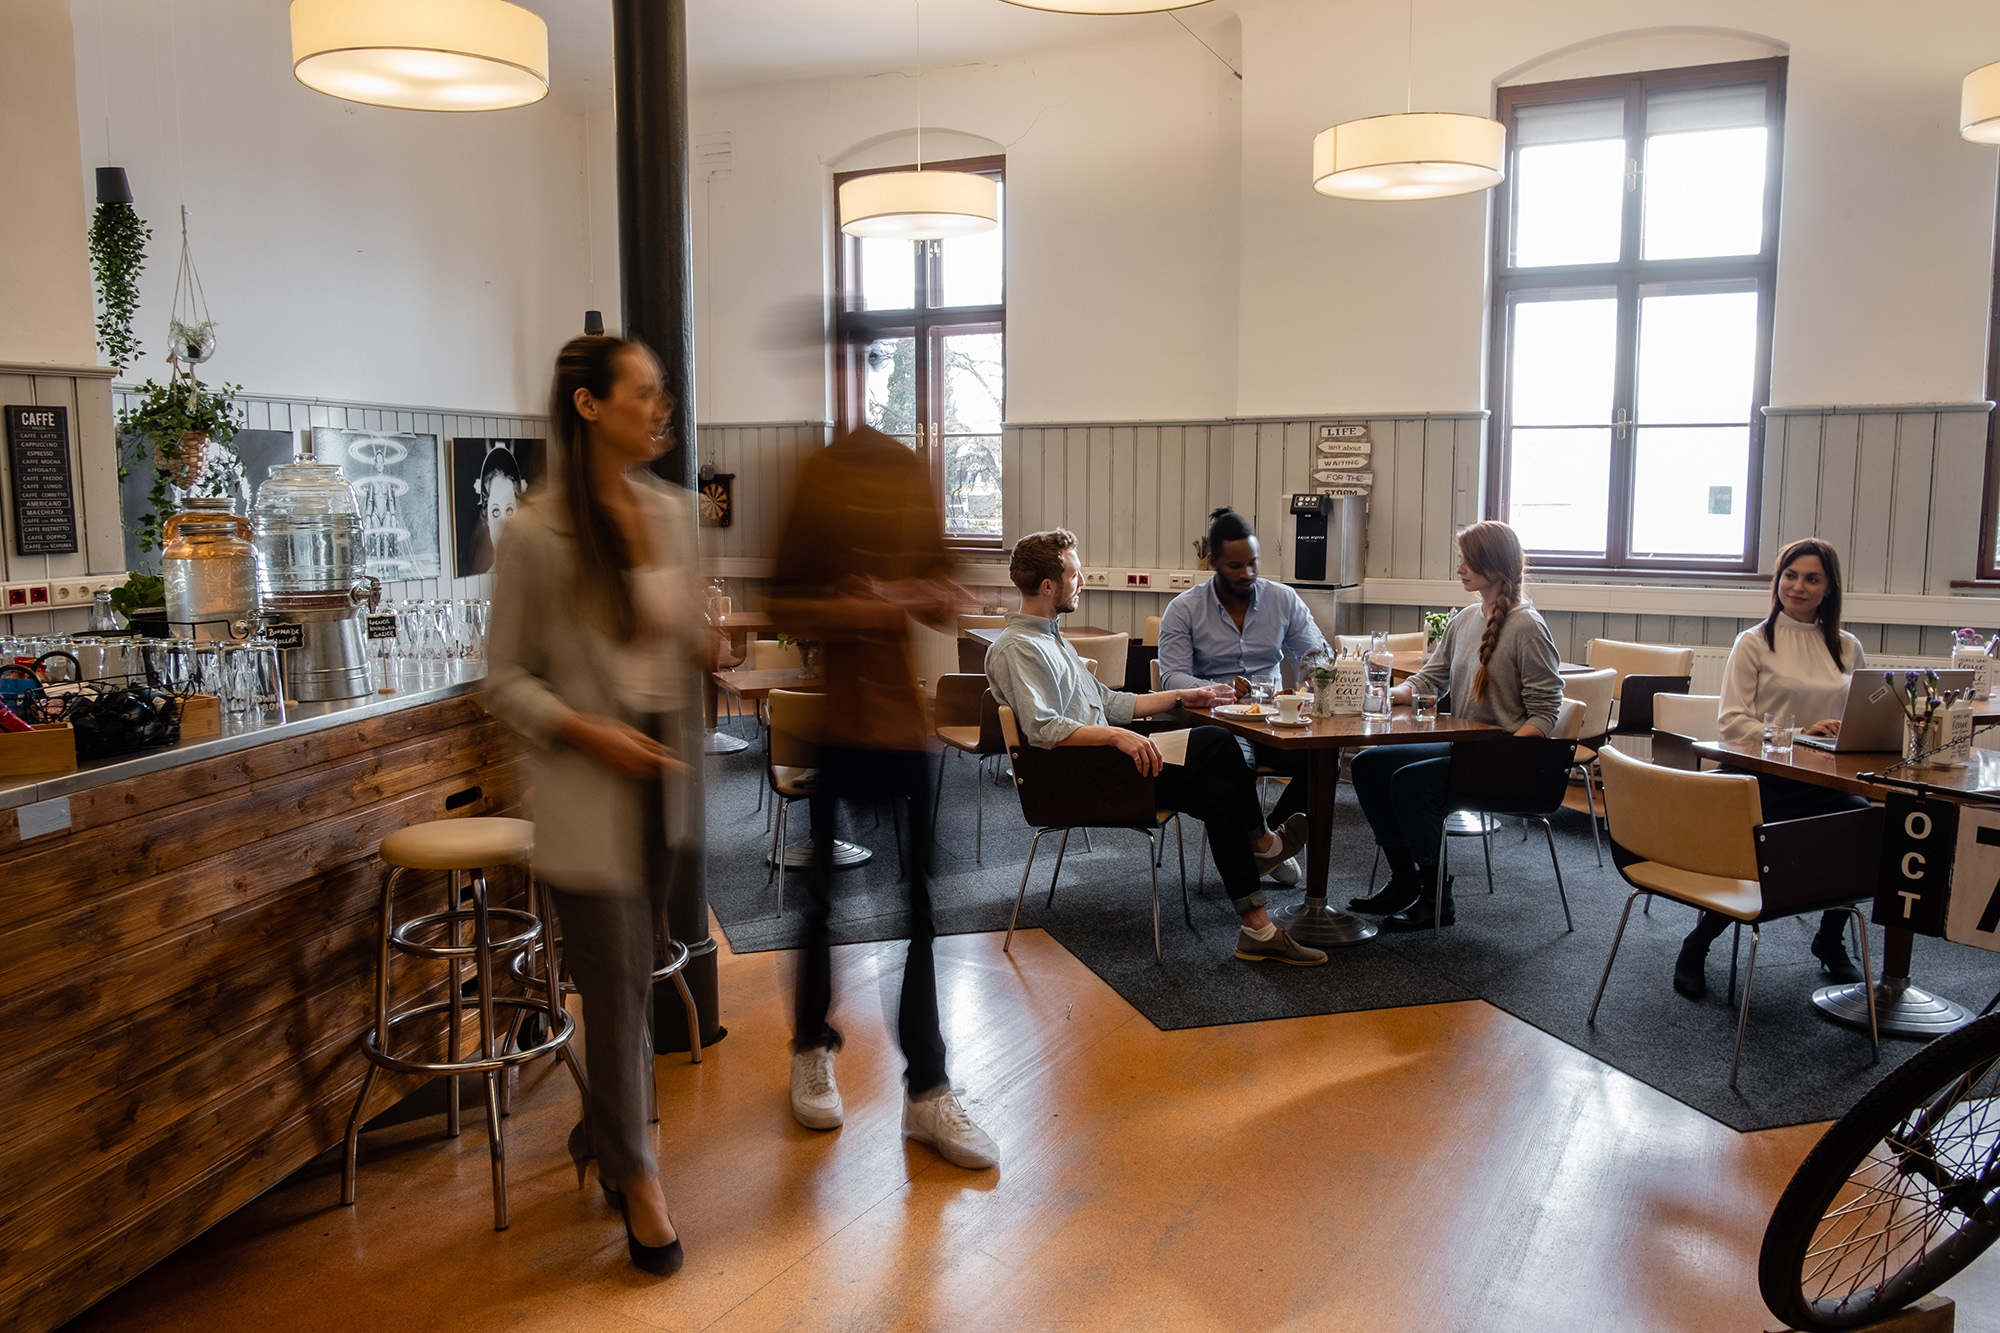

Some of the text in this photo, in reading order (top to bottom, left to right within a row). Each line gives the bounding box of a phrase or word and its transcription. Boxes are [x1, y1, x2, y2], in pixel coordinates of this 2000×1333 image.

[21, 412, 55, 426] CAFFÈ
[1327, 427, 1357, 436] LIFE
[1346, 474, 1363, 482] THE
[1335, 675, 1363, 683] love
[1335, 687, 1362, 696] eat
[1897, 811, 1932, 919] OCT
